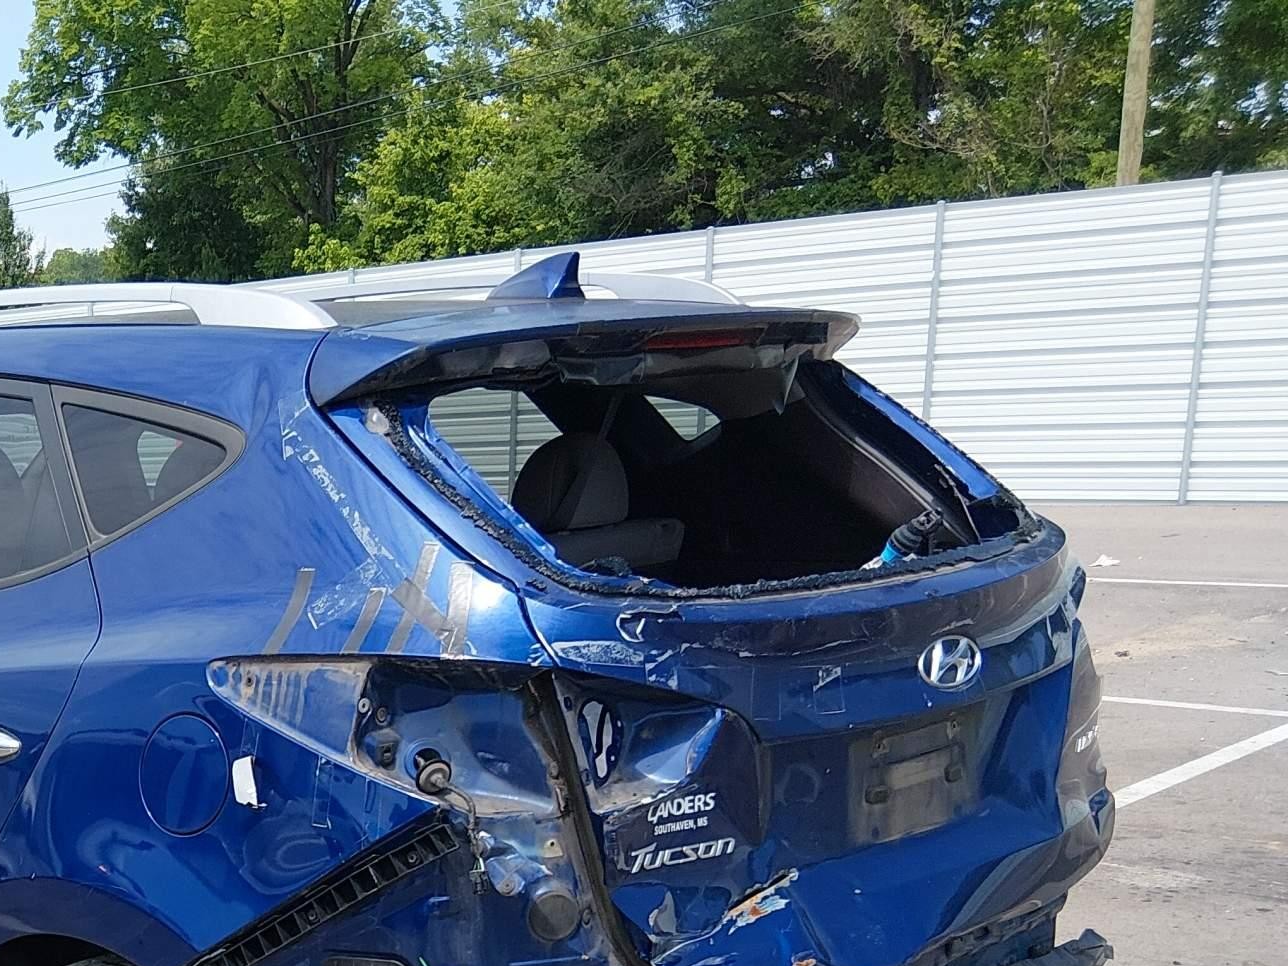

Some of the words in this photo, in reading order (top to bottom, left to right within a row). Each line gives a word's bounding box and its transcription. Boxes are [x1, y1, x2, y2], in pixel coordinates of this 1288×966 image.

[647, 792, 717, 824] LANDERS
[653, 819, 697, 836] SOUTHAVEN,
[696, 816, 709, 828] MS
